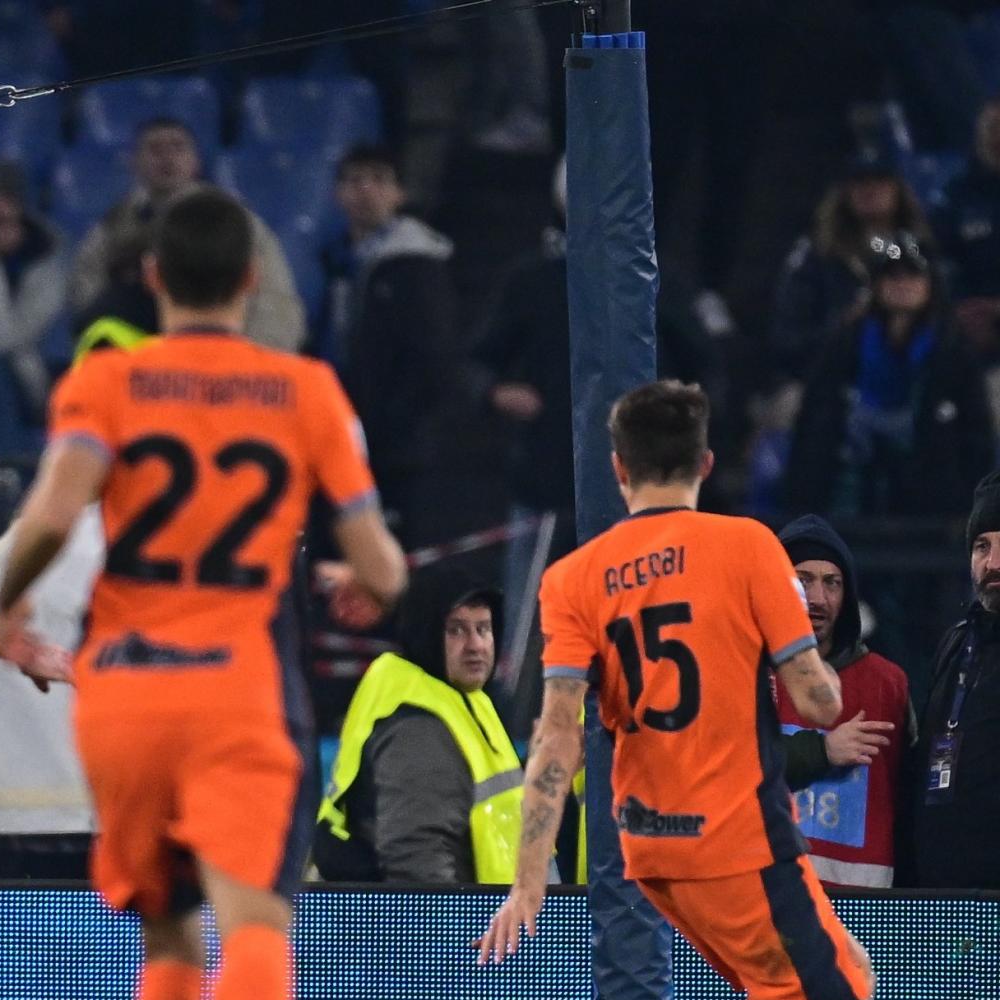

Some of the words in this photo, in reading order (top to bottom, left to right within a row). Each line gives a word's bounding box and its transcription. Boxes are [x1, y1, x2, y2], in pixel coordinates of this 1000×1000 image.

[105, 434, 291, 587] 22
[604, 545, 685, 597] ACERBI
[605, 601, 702, 733] 15
